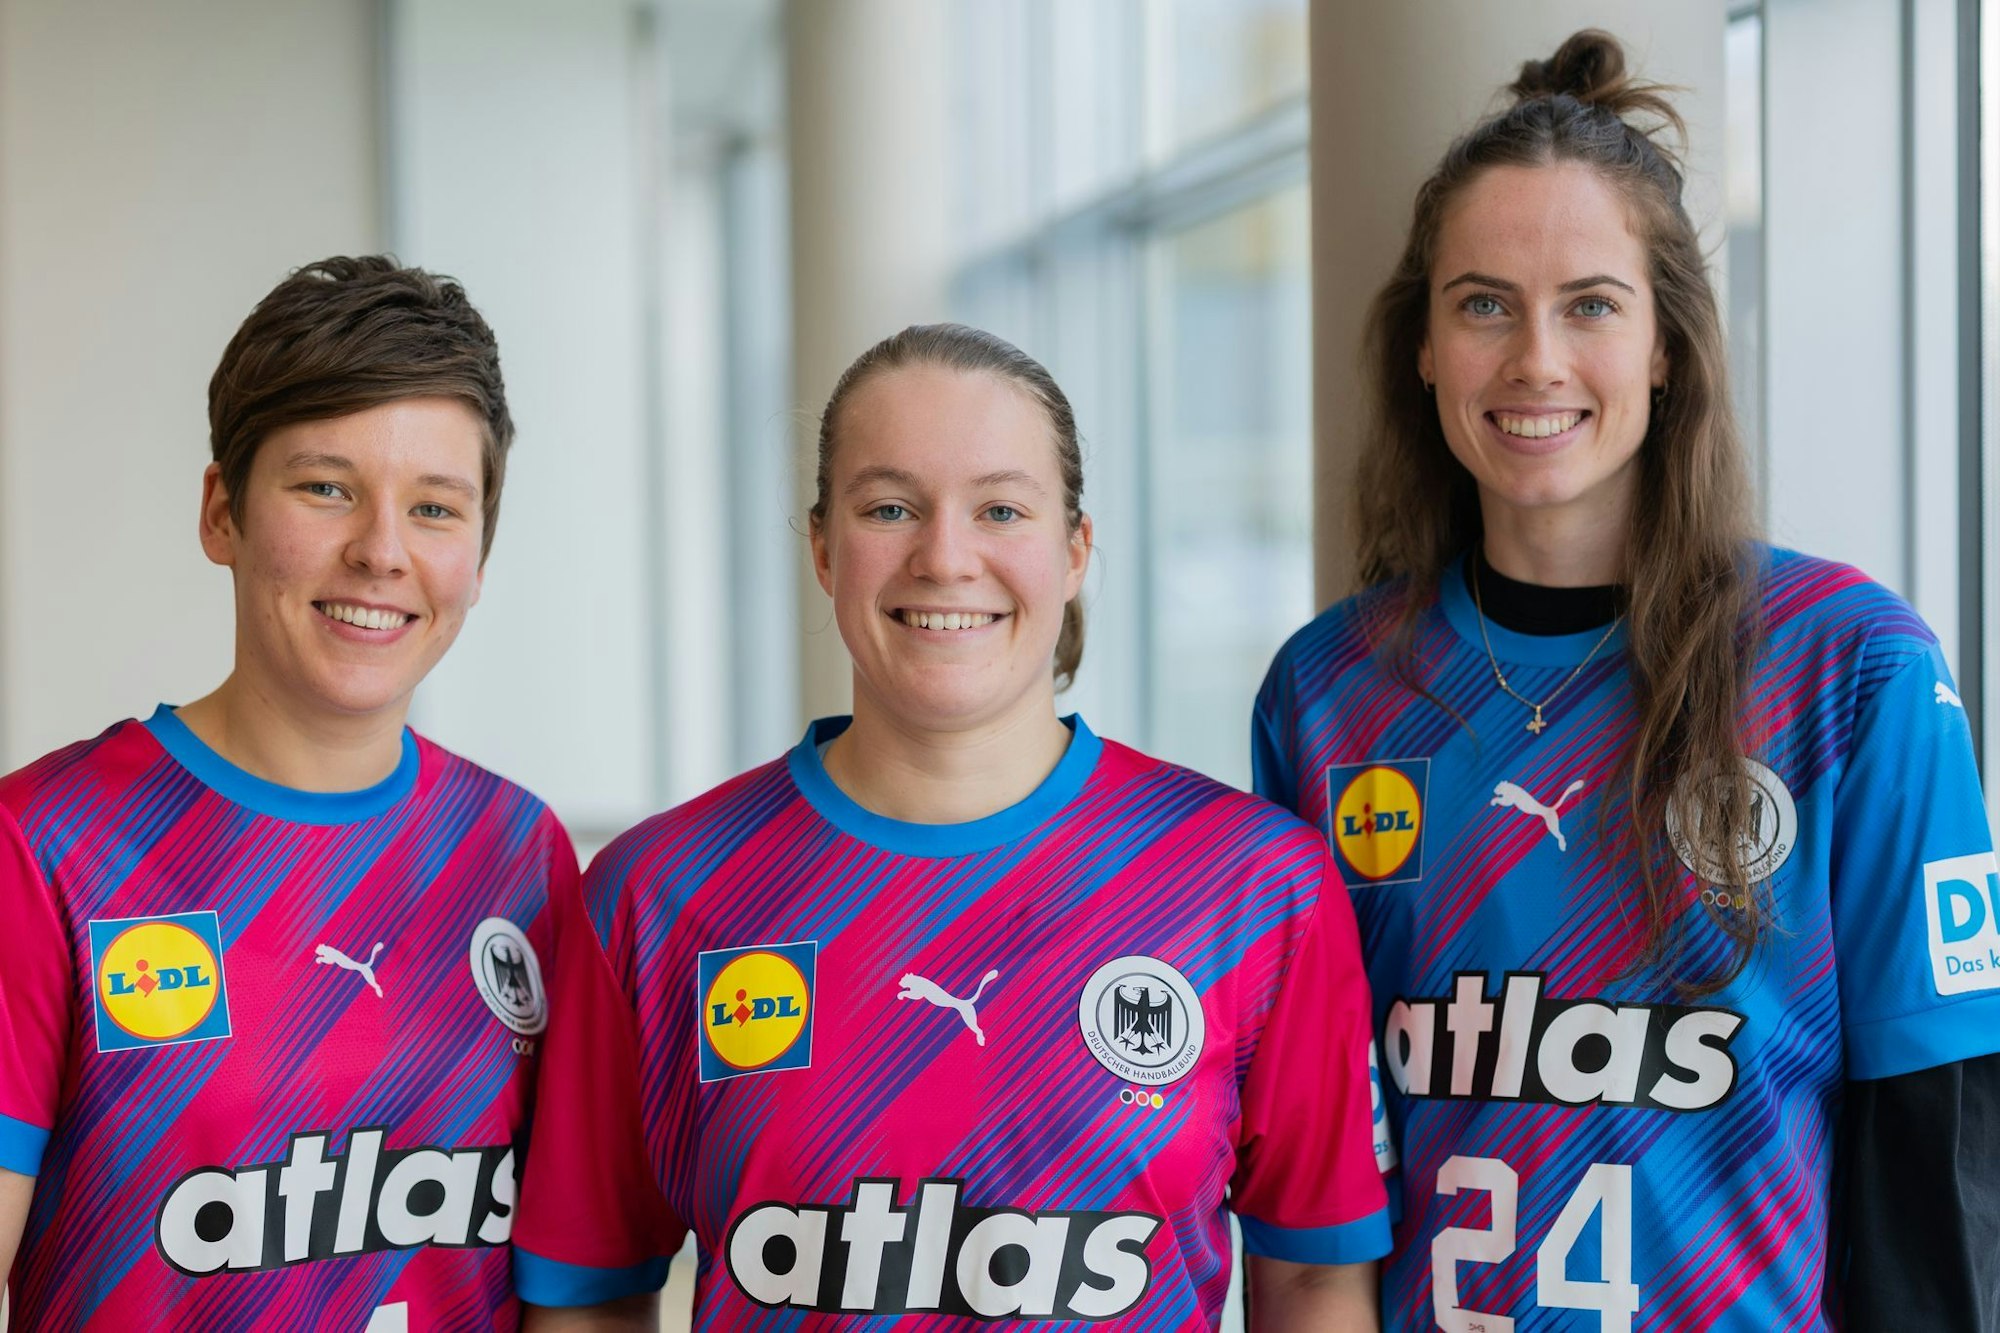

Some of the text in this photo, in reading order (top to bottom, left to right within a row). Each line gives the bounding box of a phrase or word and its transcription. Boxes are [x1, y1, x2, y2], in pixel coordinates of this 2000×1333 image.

[1945, 955, 1984, 976] Das
[1087, 1030, 1197, 1080] DEUTSCHER HANDBALLBUND
[1384, 975, 1742, 1111] atlas
[729, 1182, 1159, 1318] atlas
[1431, 1154, 1640, 1333] 24
